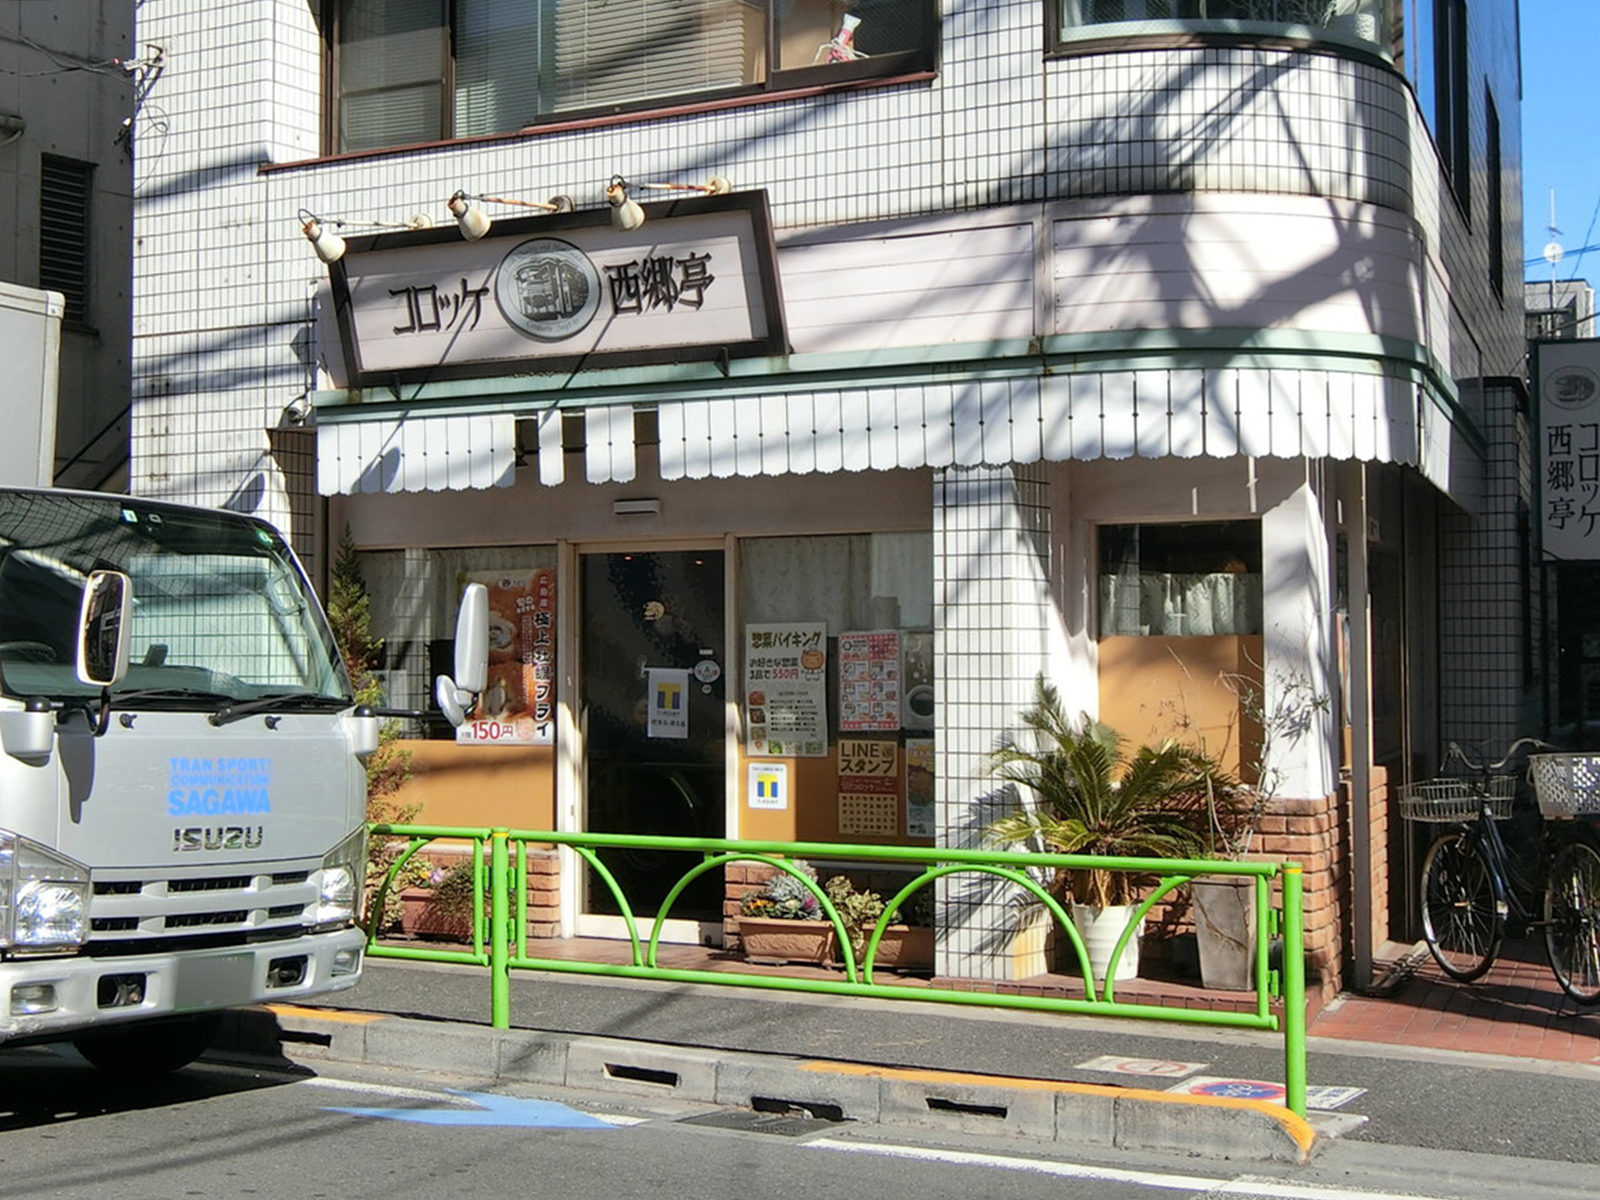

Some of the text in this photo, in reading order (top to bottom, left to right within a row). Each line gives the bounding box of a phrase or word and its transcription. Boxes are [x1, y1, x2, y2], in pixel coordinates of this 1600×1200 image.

[388, 251, 715, 335] コロッケ 西郷亭
[1547, 424, 1575, 530] 西郷亭
[1577, 423, 1600, 538] コロッケ
[752, 632, 821, 649] 惣菜バイキング
[841, 743, 879, 758] LINE
[168, 789, 270, 816] SAGAWA
[173, 826, 263, 852] ISUZU
